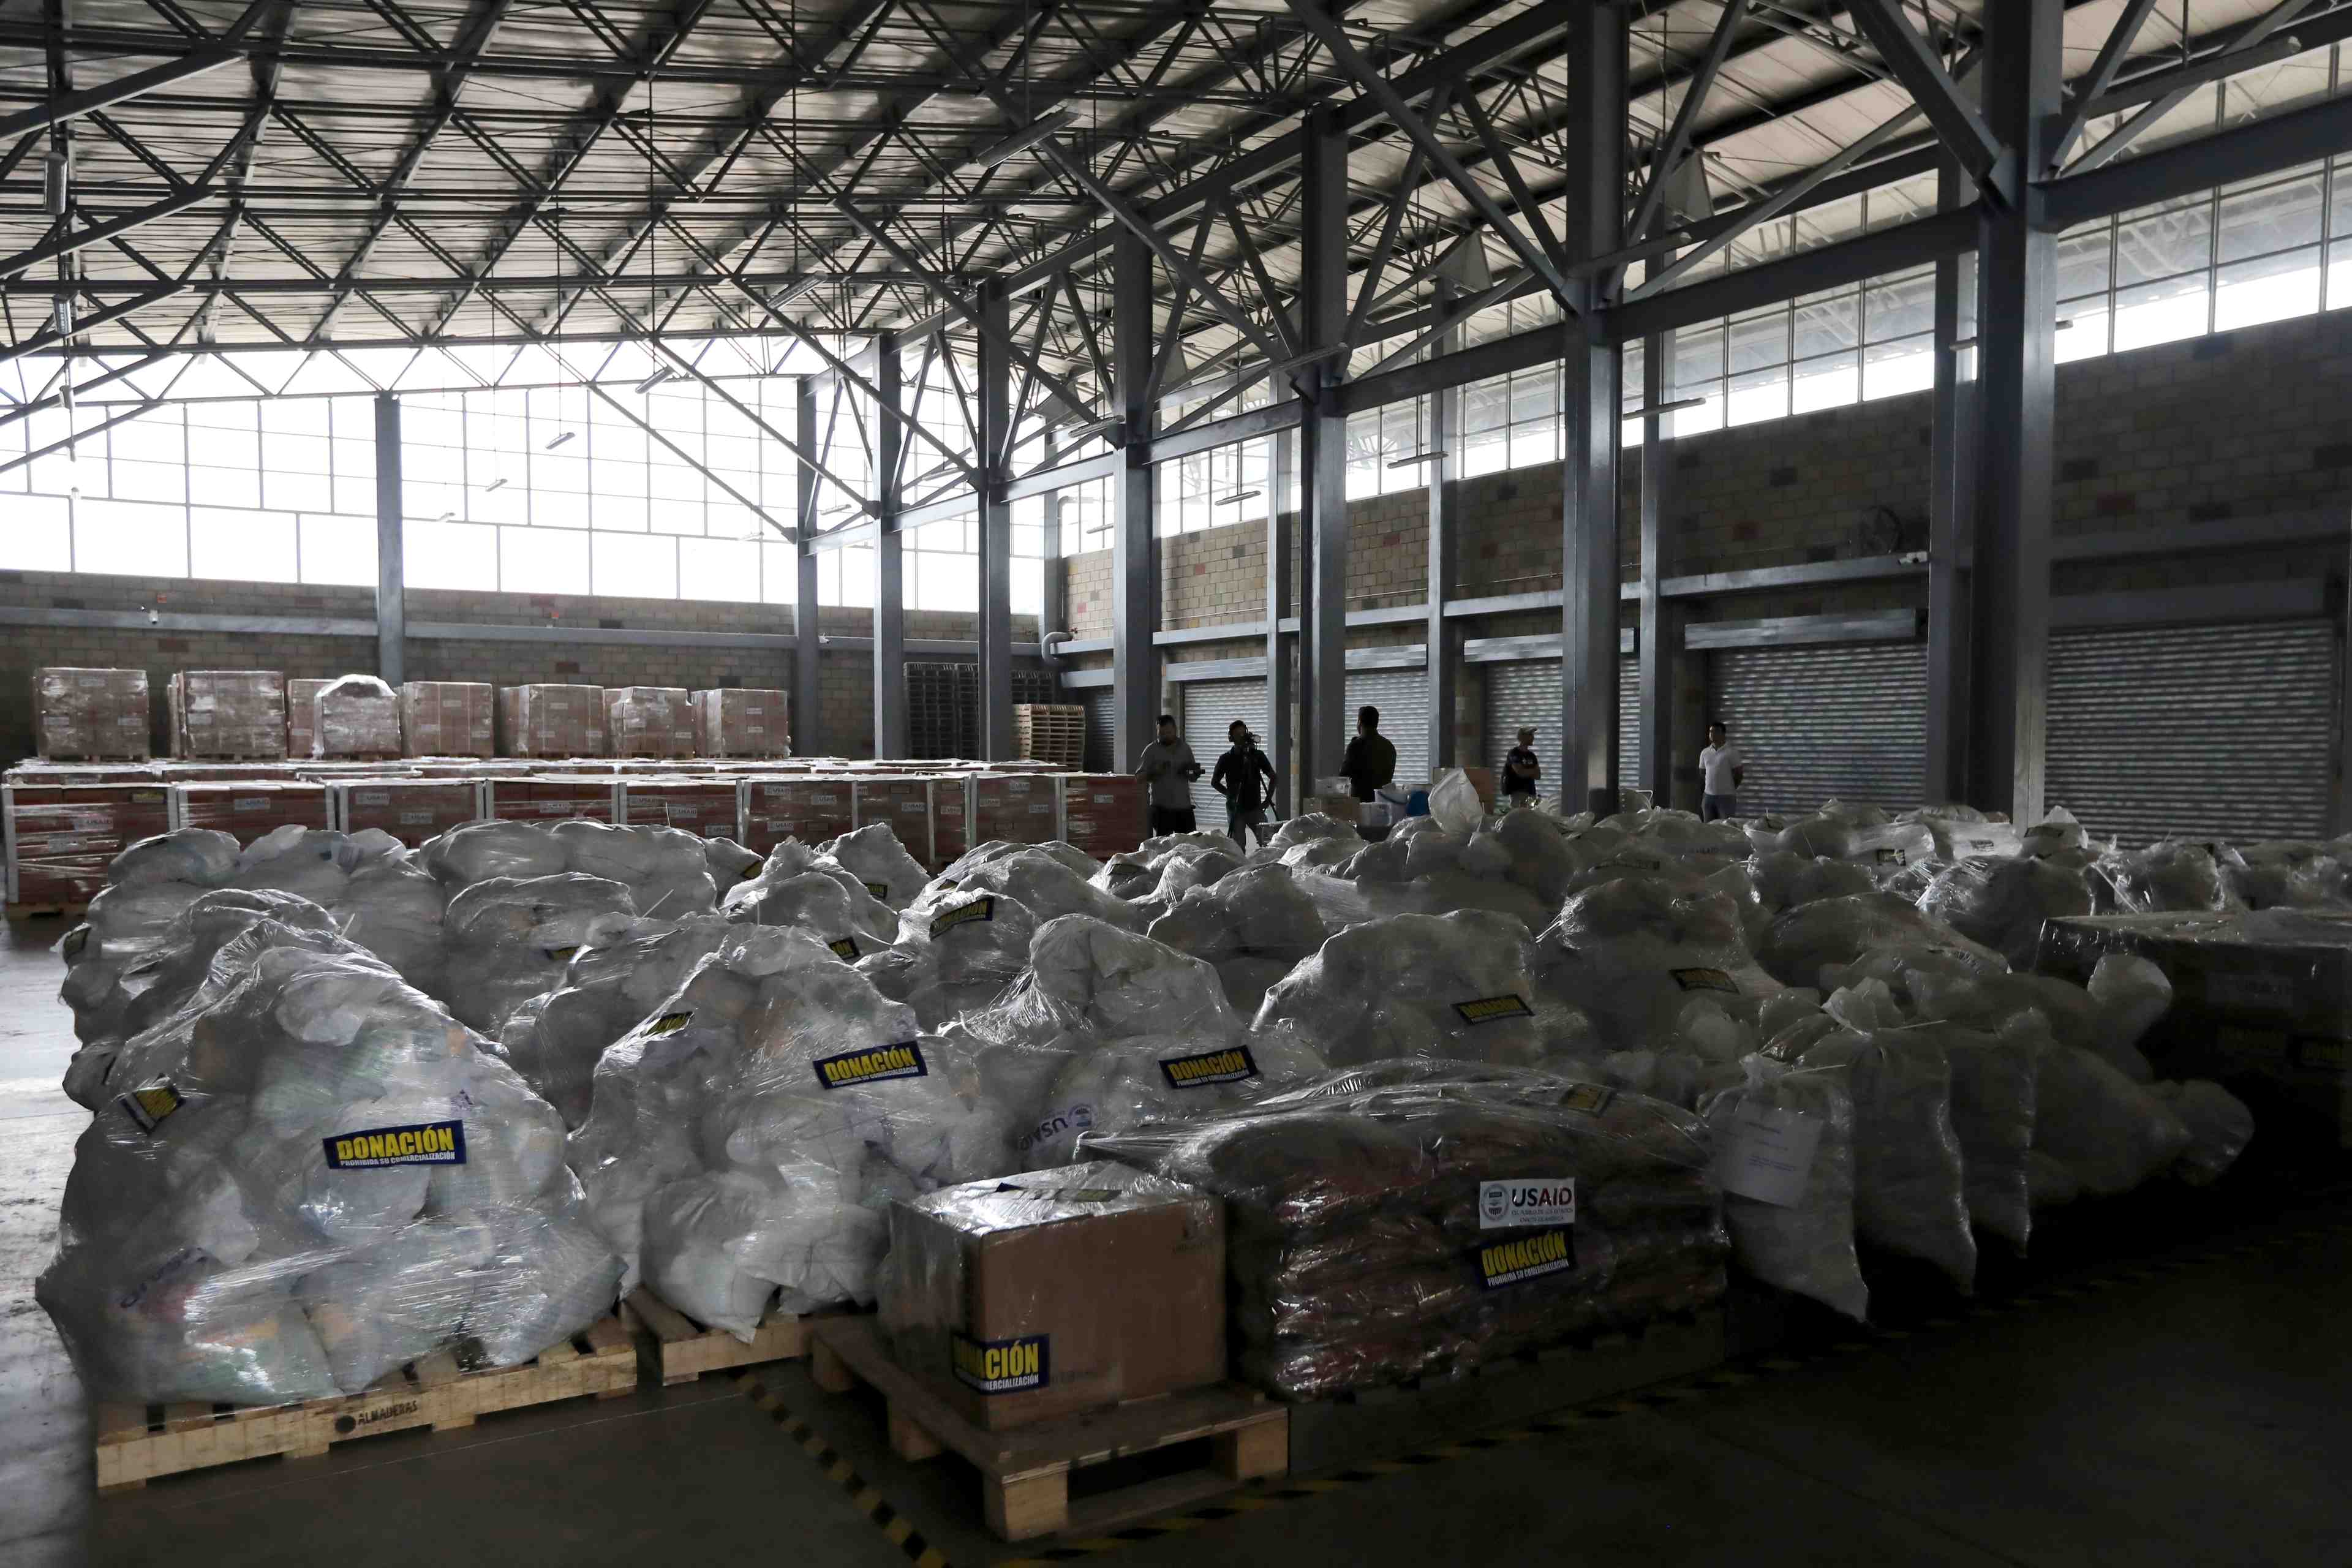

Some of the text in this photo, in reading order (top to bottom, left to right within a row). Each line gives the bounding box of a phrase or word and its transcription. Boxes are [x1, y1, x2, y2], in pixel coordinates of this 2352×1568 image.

[823, 1045, 917, 1082] DONACIÓN
[1167, 1050, 1246, 1081] DONACIÓN
[336, 1125, 455, 1159] DONACIÓN
[1018, 1117, 1068, 1150] USAID
[391, 1152, 456, 1164] COMERCIALIZACIÓN
[1512, 1188, 1572, 1207] USAID
[1481, 1230, 1568, 1276] DONACIÓN
